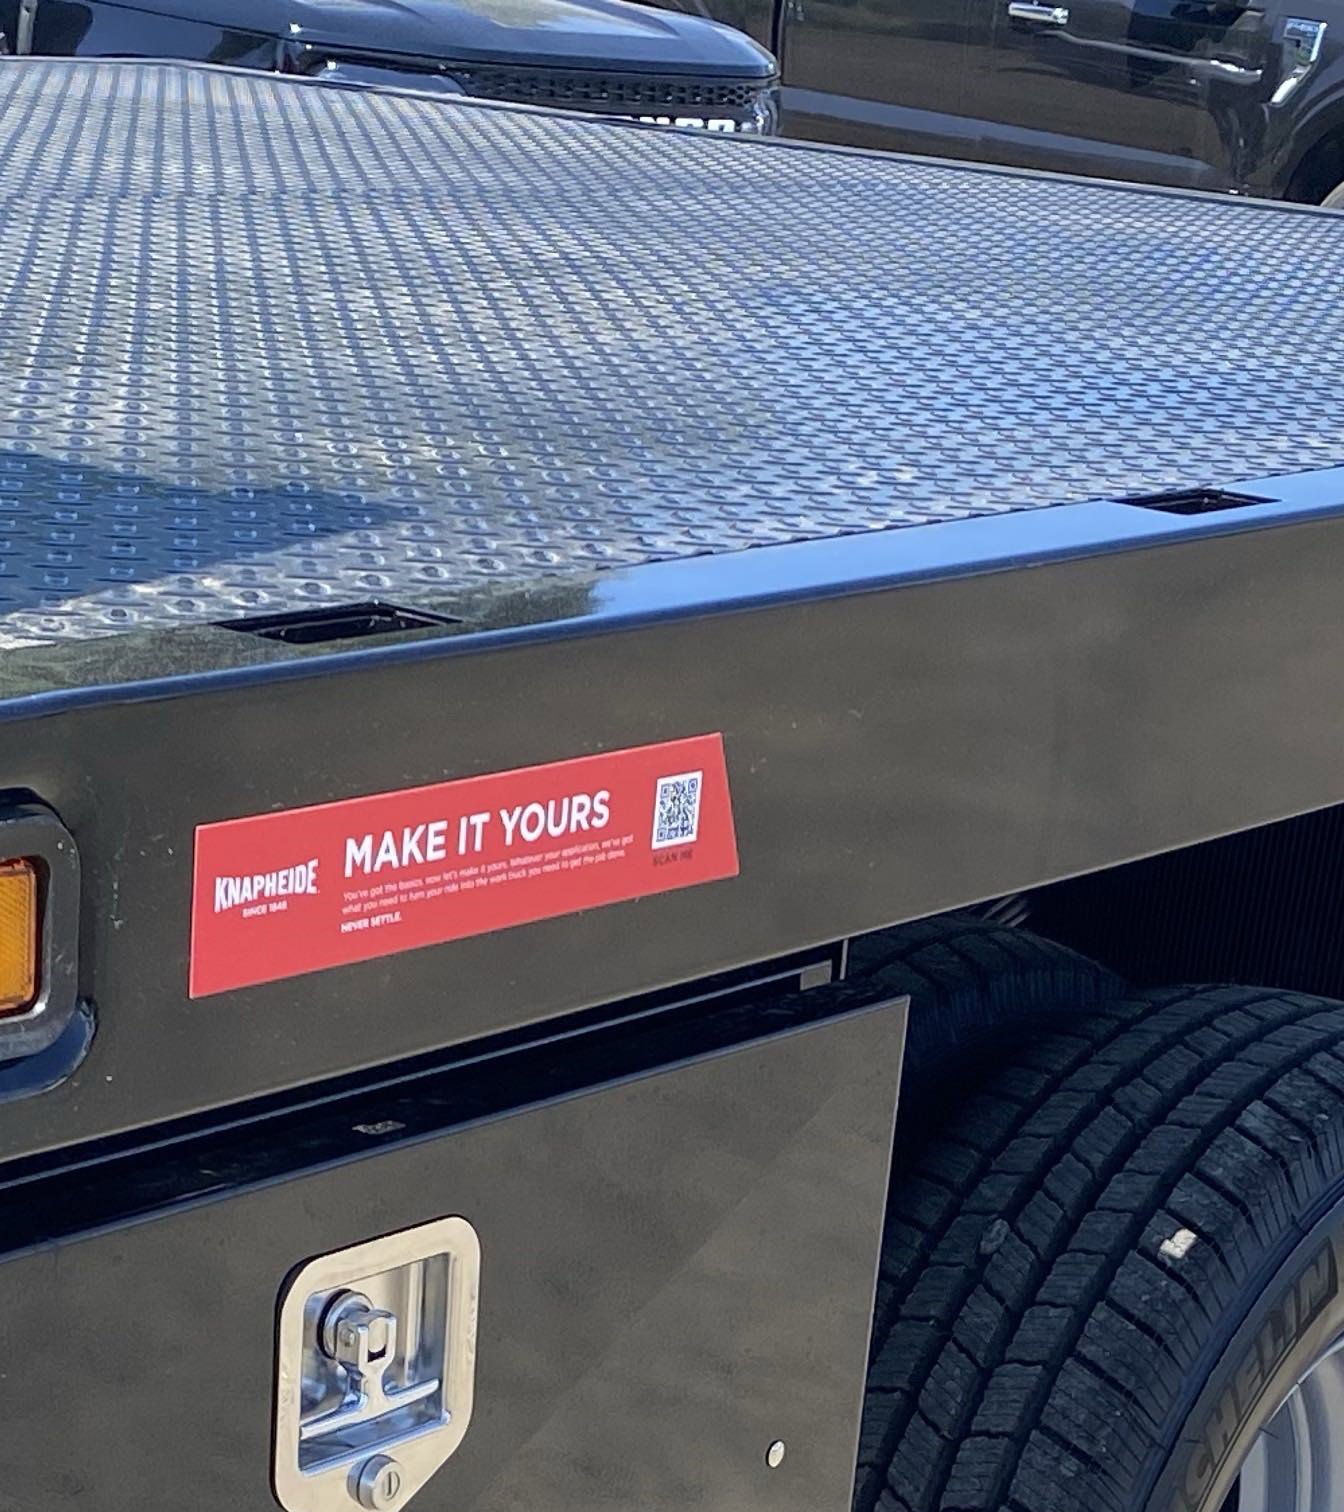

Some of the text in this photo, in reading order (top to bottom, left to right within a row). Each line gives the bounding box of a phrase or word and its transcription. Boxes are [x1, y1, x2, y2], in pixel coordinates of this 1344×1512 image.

[343, 789, 610, 878] MAKE IT YOURS
[214, 858, 319, 914] KNAPHEIDE
[242, 904, 267, 918] SINCE
[340, 918, 369, 934] NEVER
